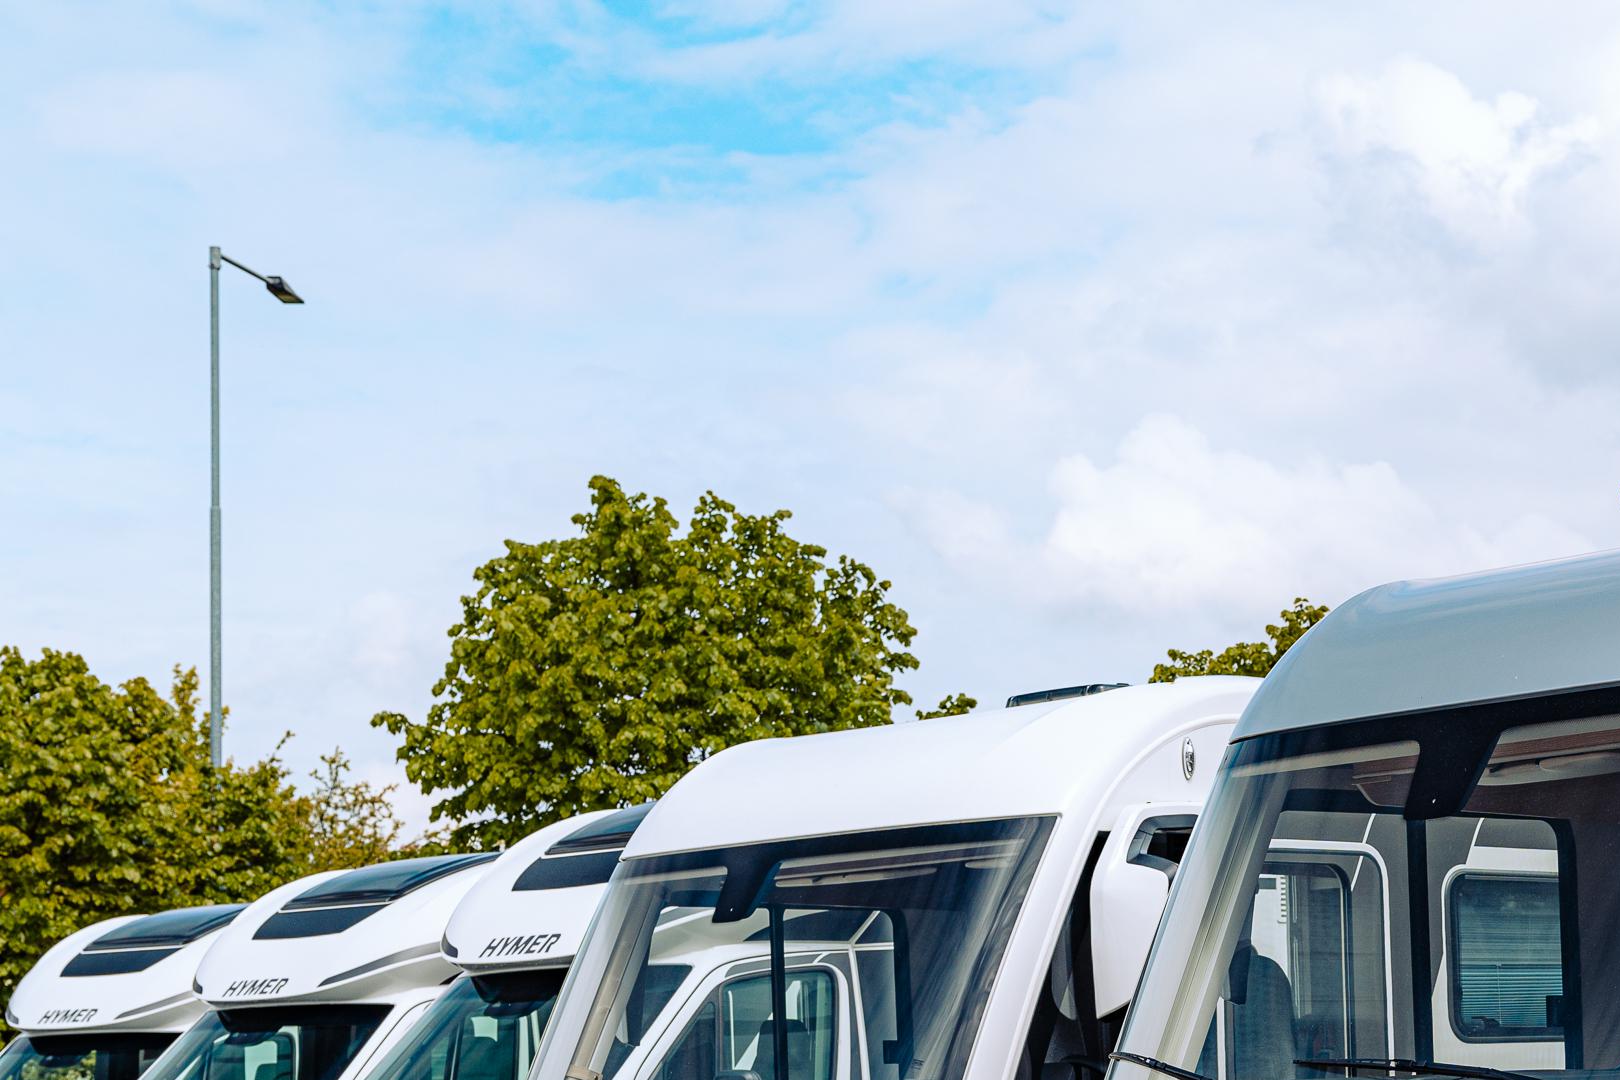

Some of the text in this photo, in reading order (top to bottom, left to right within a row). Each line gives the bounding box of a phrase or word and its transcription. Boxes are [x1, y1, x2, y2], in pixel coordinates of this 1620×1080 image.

[478, 933, 562, 959] HYMER
[222, 977, 289, 998] HYMER
[37, 1009, 98, 1024] HYMER
